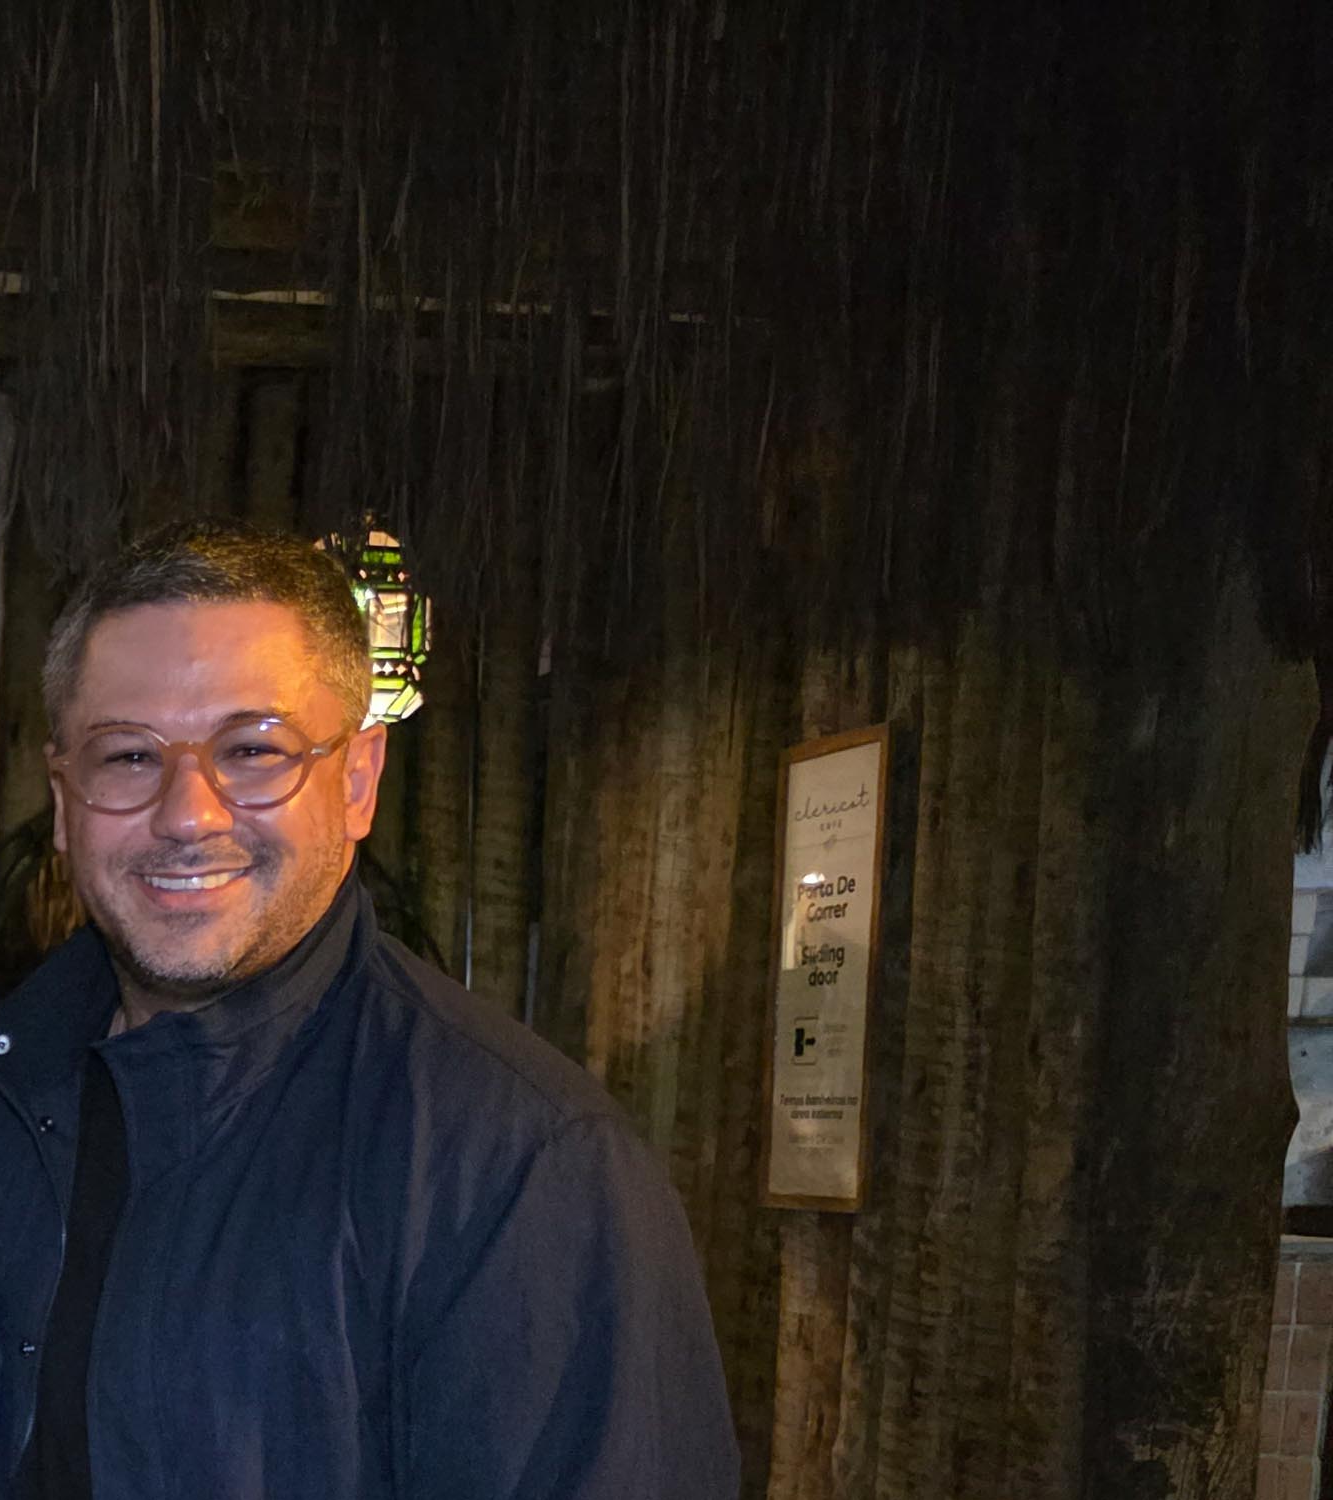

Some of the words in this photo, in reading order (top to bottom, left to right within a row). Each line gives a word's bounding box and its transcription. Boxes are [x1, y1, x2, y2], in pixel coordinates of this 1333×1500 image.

[797, 880, 834, 902] Porta
[837, 875, 857, 895] De
[808, 965, 839, 987] door
